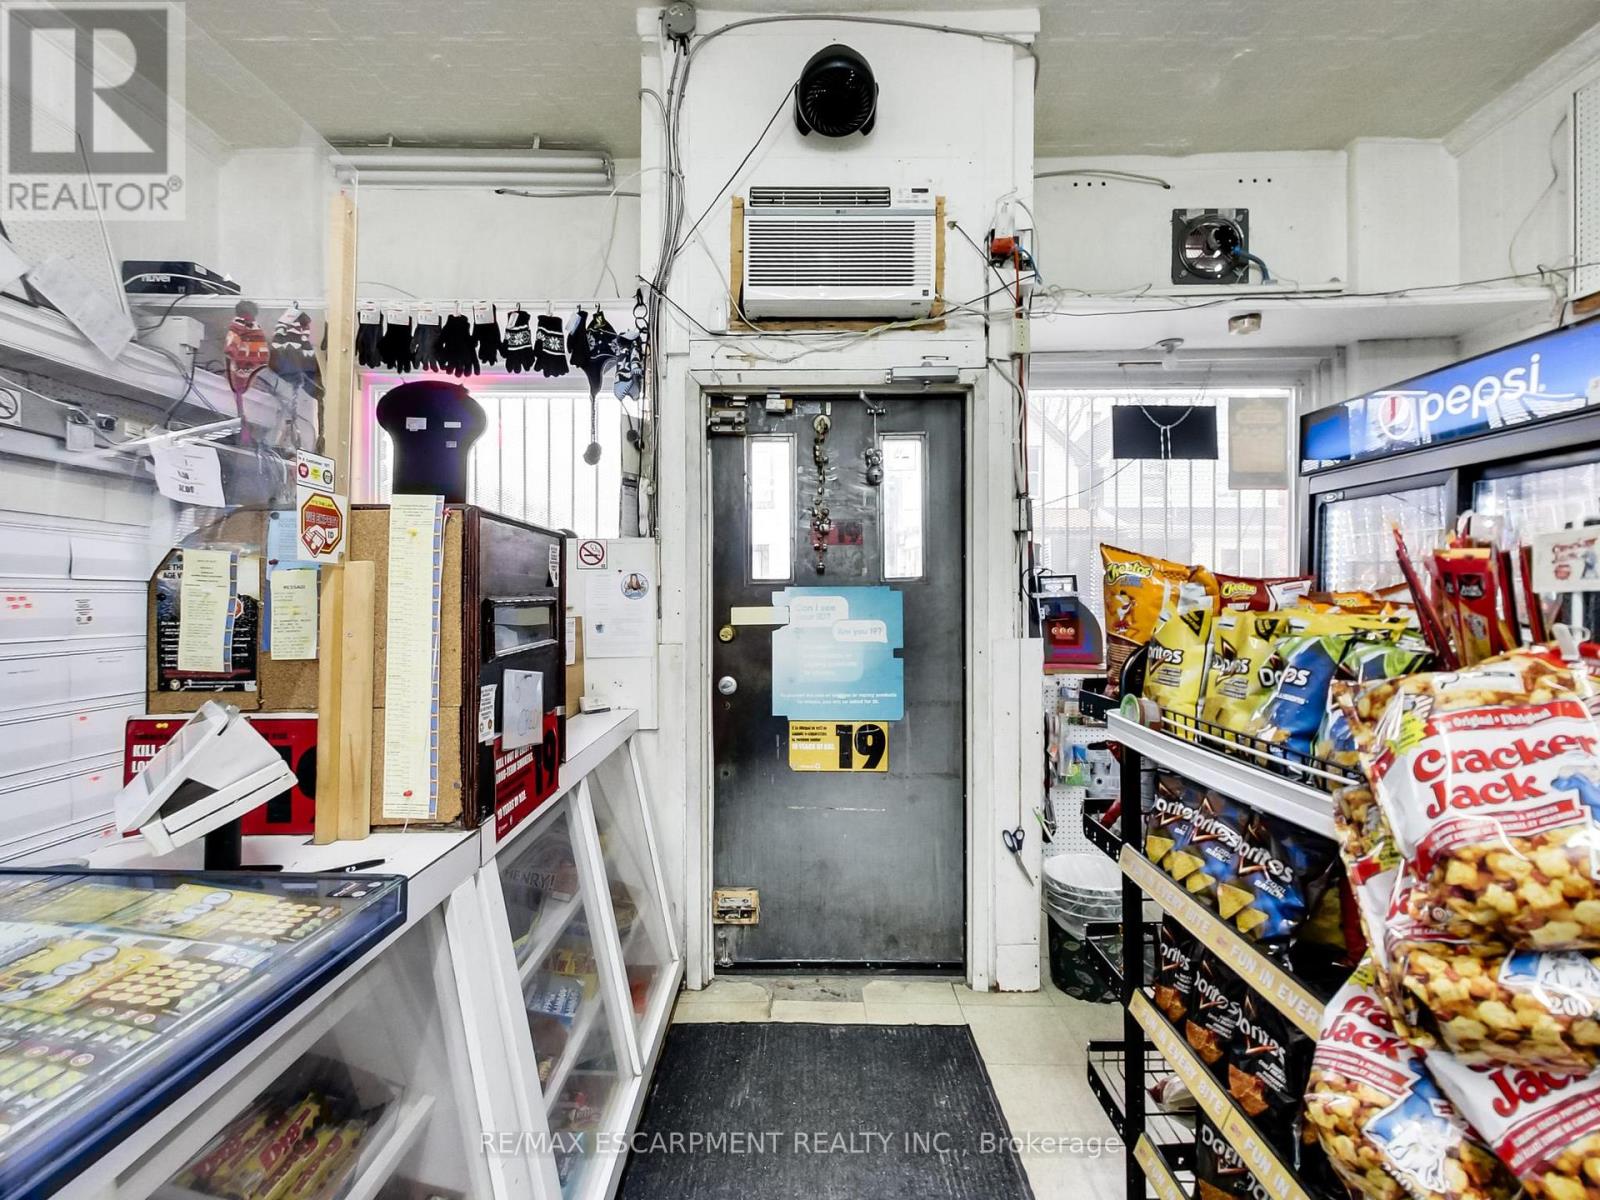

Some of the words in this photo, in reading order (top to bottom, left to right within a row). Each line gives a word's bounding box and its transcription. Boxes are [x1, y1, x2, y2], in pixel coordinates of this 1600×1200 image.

[1421, 353, 1542, 424] pepsi
[1107, 561, 1153, 584] Cheetos
[836, 724, 886, 769] 19
[1413, 734, 1598, 783] Cracker
[1426, 773, 1547, 820] Jack
[1230, 943, 1256, 974] FUN
[1259, 967, 1275, 990] IN
[1276, 982, 1321, 1028] EVER
[1244, 1136, 1272, 1176] FUN
